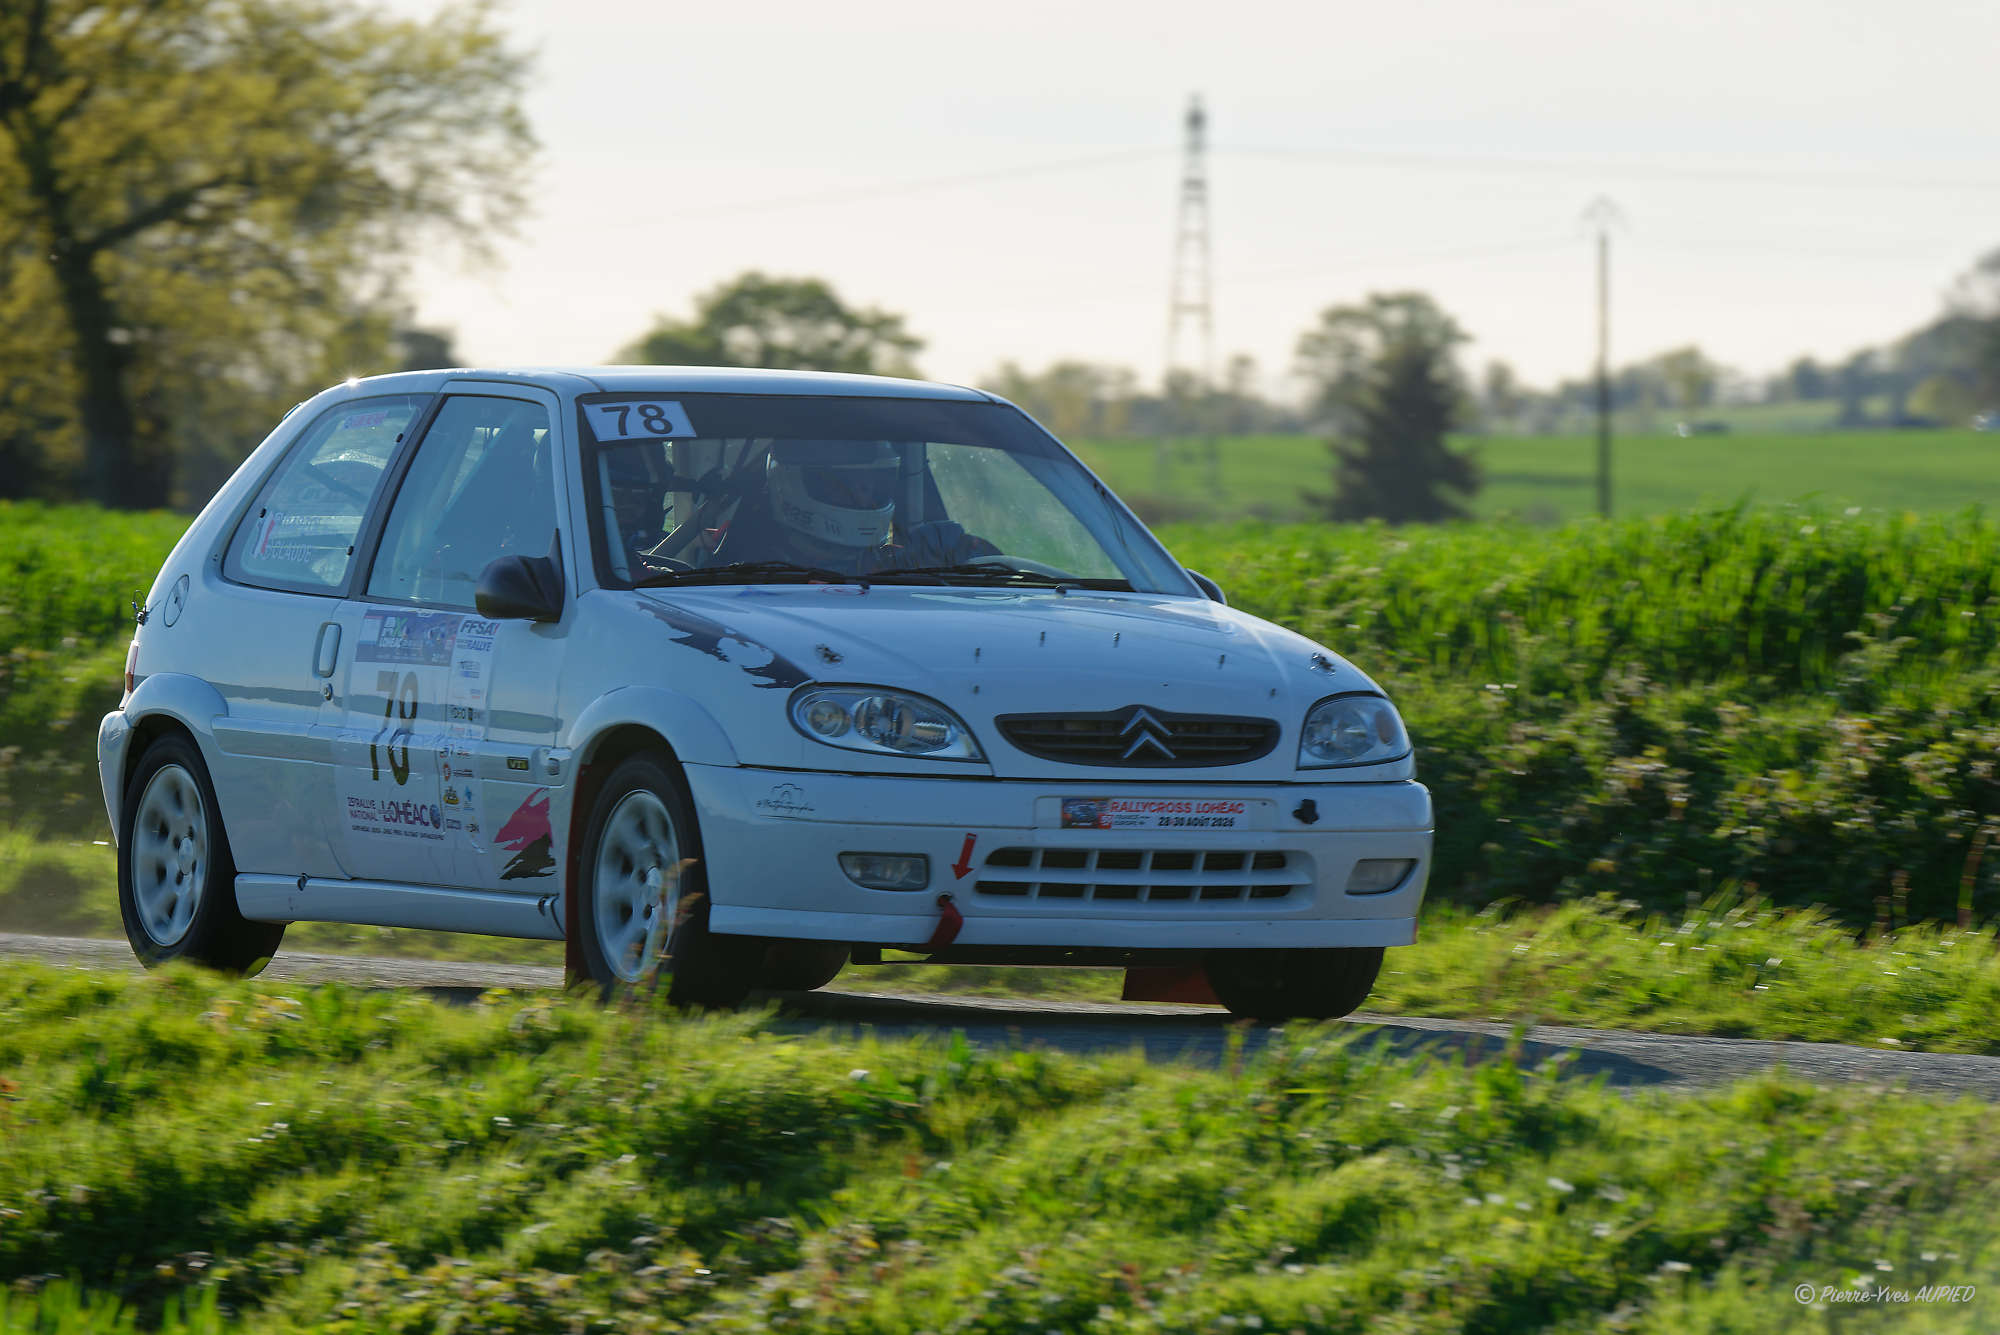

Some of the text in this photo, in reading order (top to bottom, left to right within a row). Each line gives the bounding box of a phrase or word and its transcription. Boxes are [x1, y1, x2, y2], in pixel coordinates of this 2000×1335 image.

[601, 404, 674, 436] 78
[368, 670, 419, 786] 78
[381, 799, 431, 827] LOHÉAC
[1110, 800, 1246, 814] RALLYCROSS LOHÉAC
